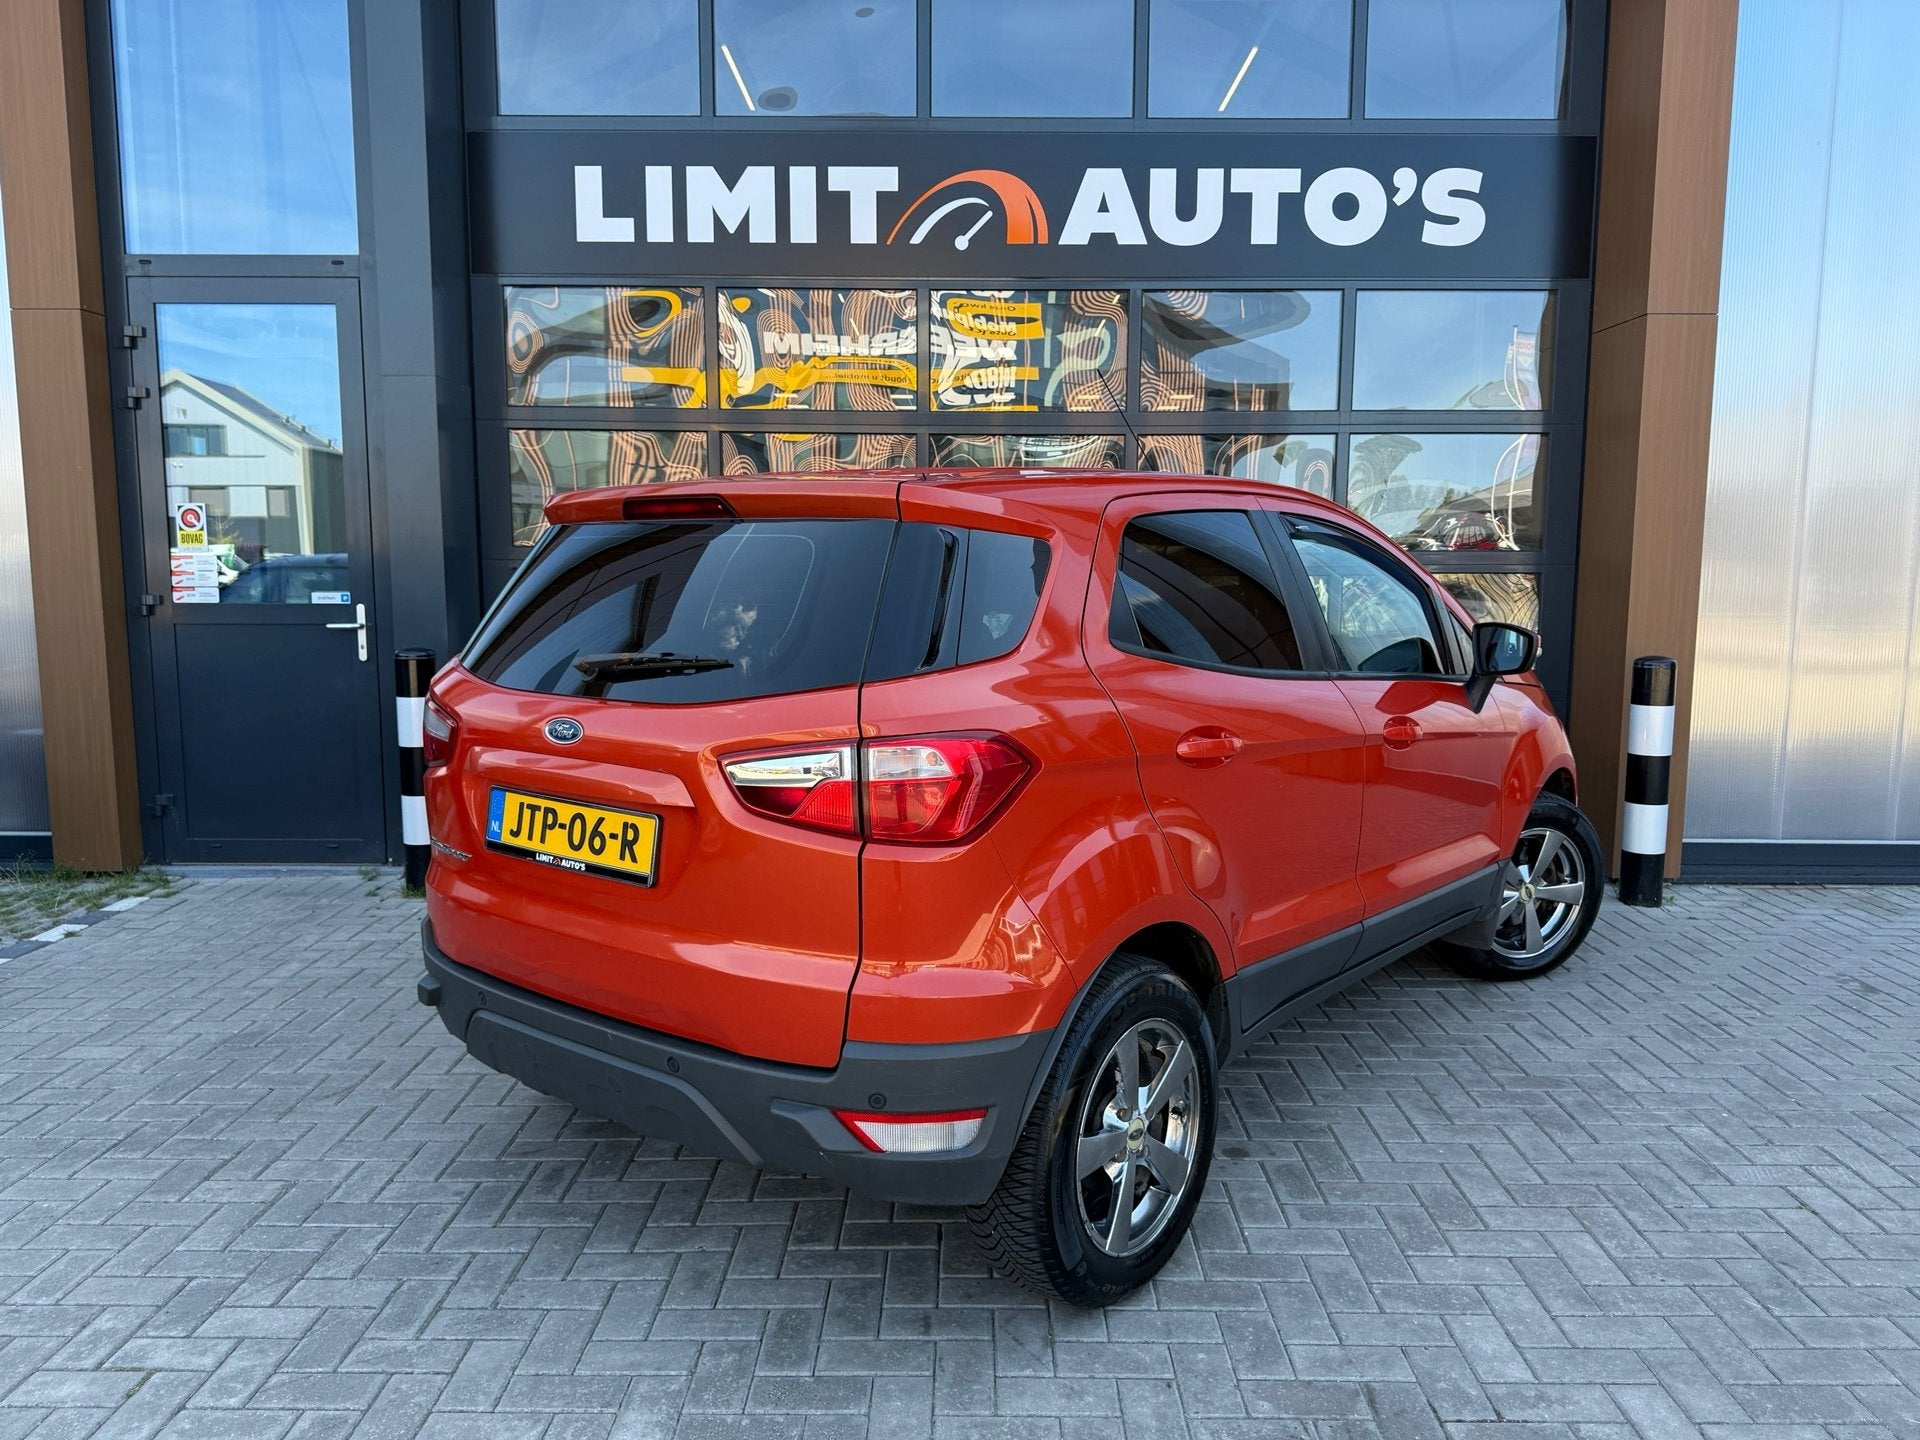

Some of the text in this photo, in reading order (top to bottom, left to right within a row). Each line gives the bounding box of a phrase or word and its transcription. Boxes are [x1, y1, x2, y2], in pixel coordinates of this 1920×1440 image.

[574, 165, 1486, 247] LIMIT AUTO'S
[181, 533, 203, 544] BOVAG
[552, 723, 575, 739] Ford
[491, 819, 501, 833] NL
[509, 801, 640, 864] JTP-06-R
[535, 852, 586, 871] LIMIT AUTO'S
